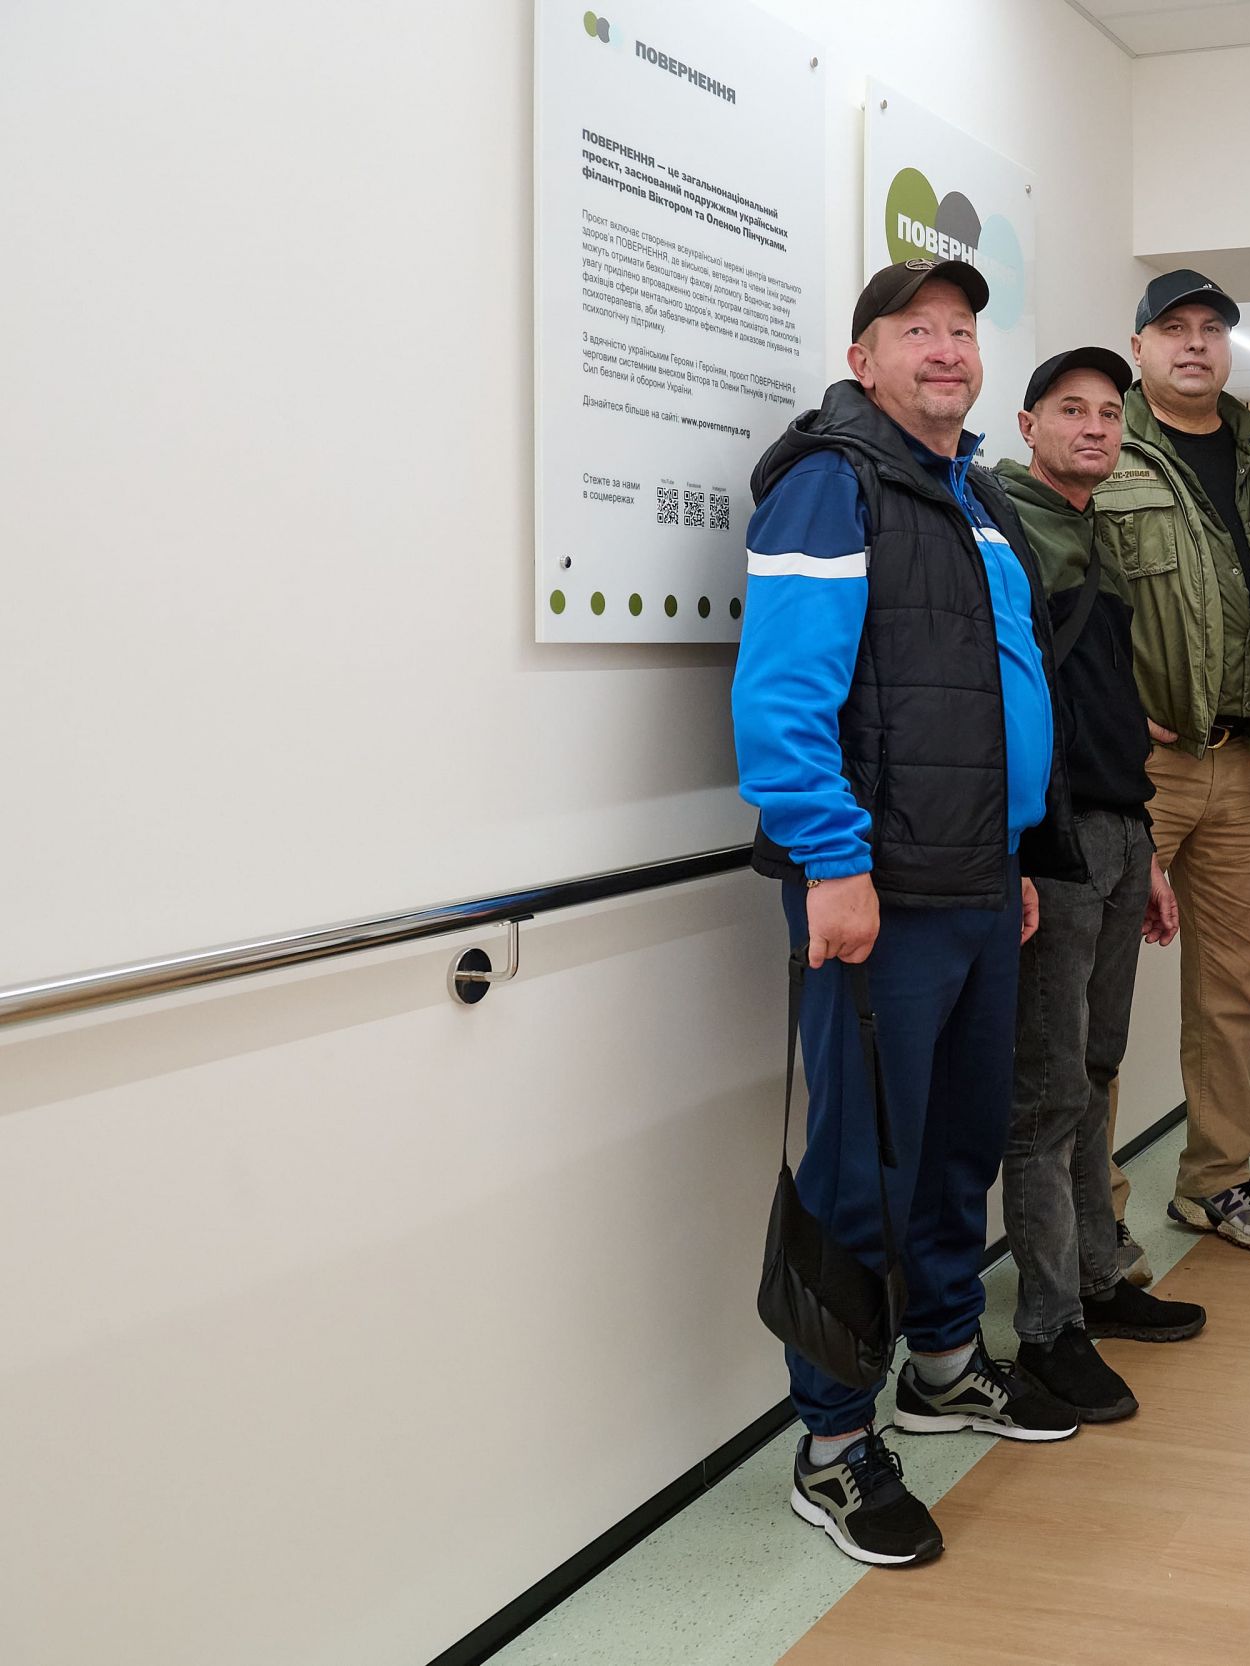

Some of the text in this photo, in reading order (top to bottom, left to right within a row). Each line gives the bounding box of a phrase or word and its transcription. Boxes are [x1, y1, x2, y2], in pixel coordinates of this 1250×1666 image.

[635, 39, 736, 105] ПОВЕРНЕННЯ
[582, 127, 654, 168] ПОВЕРНЕННЯ
[667, 166, 679, 180] це
[681, 170, 777, 219] загальнонаціональний
[582, 148, 787, 240] проєкт, заснований подружжям українських
[582, 163, 786, 254] філантропів Віктором та Оленою Пінчуками.
[897, 212, 992, 270] ПОВЕРН
[582, 302, 665, 334] психологічну підтримку.
[582, 361, 598, 375] Сил
[599, 364, 628, 381] безпеки
[636, 373, 665, 391] оборони
[582, 348, 617, 365] черговим
[618, 356, 656, 373] системним
[657, 366, 685, 380] внеском
[686, 370, 710, 387] Віктора
[711, 378, 718, 388] та
[719, 378, 739, 393] Олени
[740, 383, 763, 400] Пінчуків
[768, 391, 795, 407] підтримку
[589, 332, 626, 352] вдячністю
[627, 342, 669, 363] українським
[670, 352, 694, 369] Героям
[698, 359, 728, 378] Героїням,
[729, 370, 749, 383] проєкт
[749, 372, 791, 392] ПОВЕРНЕННЯ
[582, 394, 750, 439] Дізнайтеся більше на сайті: www.povernennya.org
[582, 472, 640, 490] Стежте за нами
[589, 491, 634, 505] соцмережах
